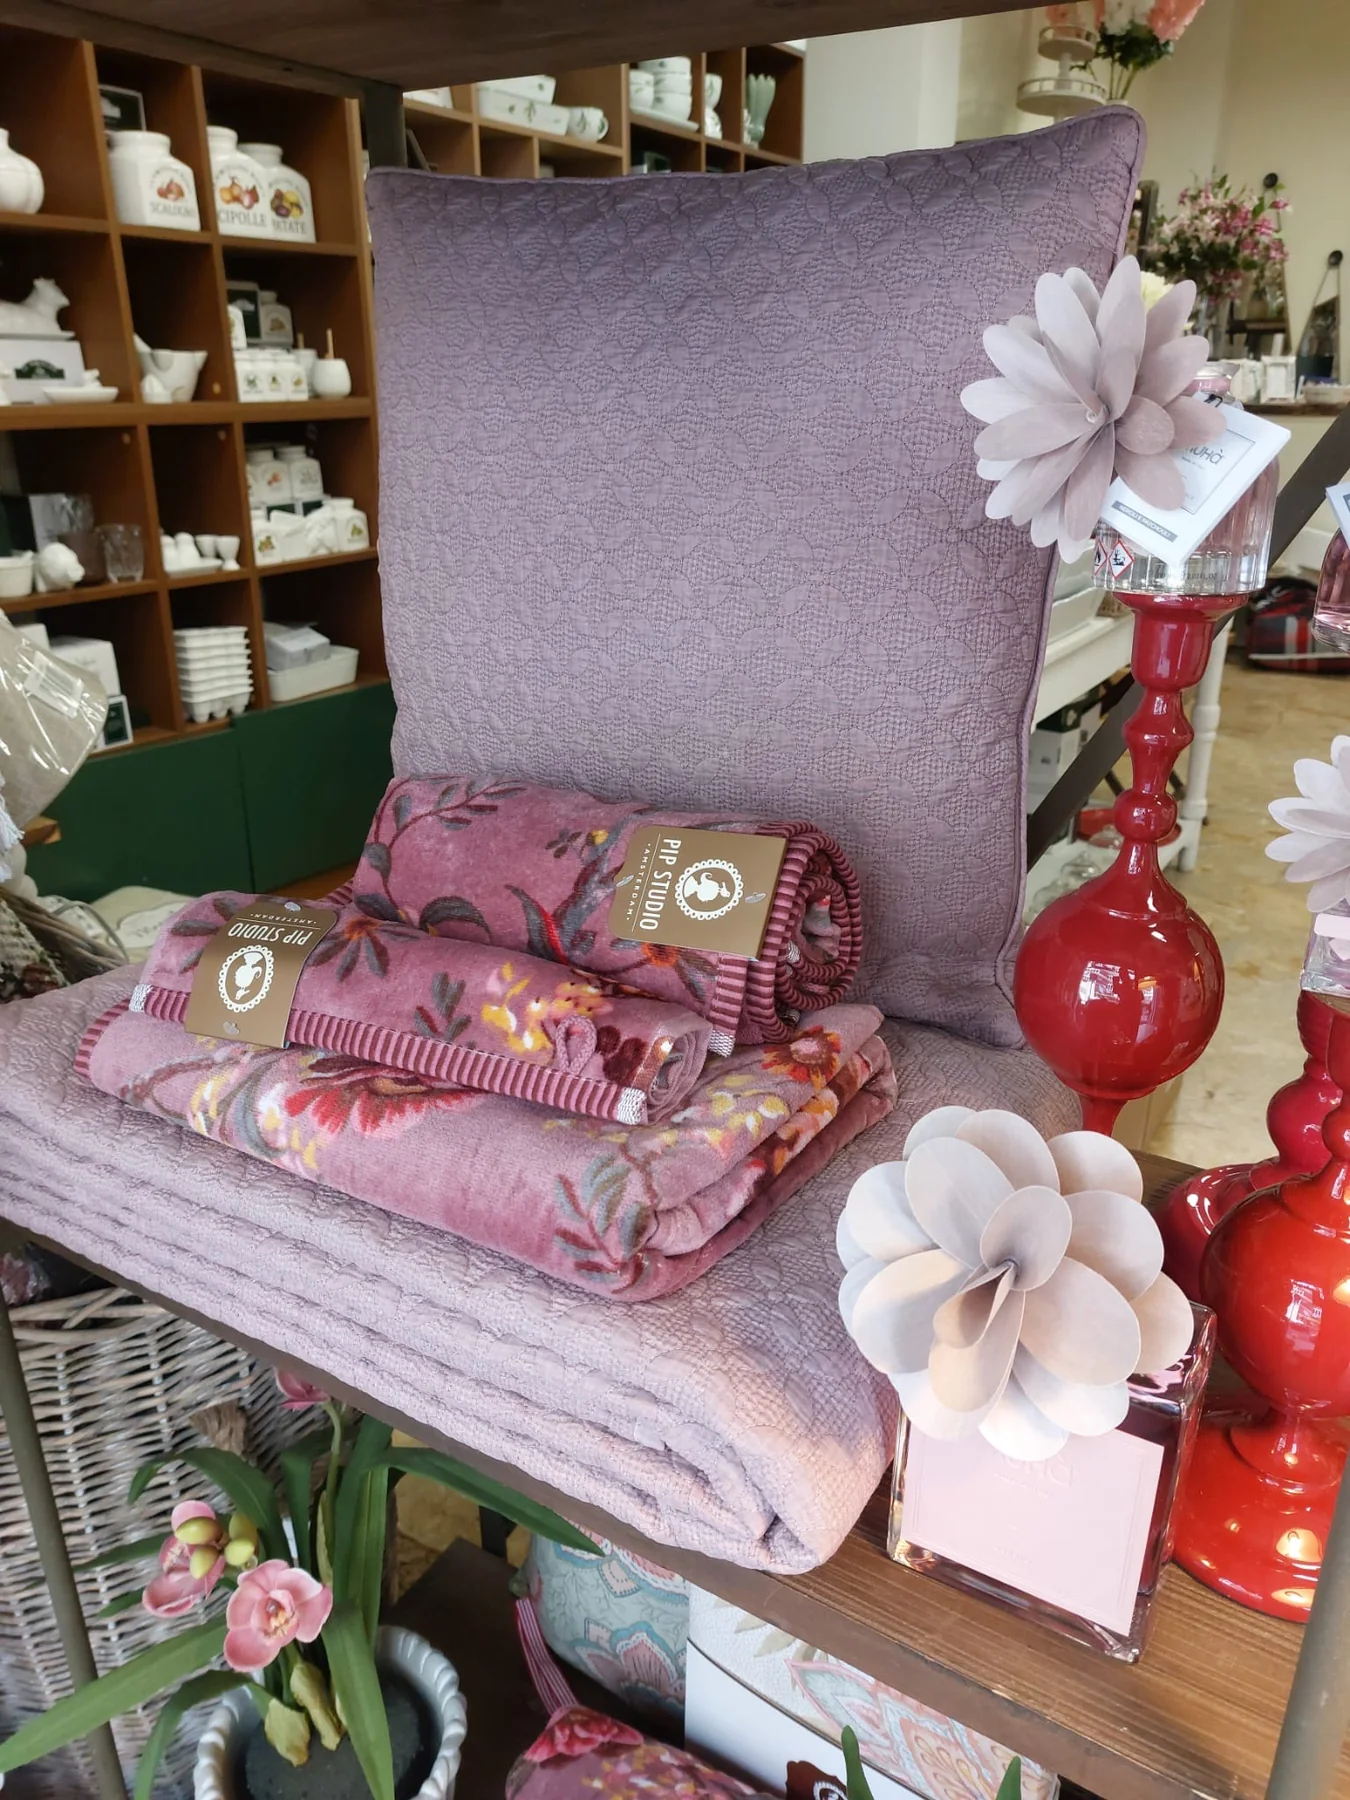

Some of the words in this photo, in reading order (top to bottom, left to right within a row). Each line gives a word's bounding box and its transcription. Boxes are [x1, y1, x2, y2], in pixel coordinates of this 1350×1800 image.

[218, 208, 267, 227] CIPOLLE
[658, 838, 681, 865] PIP
[639, 870, 672, 930] STUDIO
[228, 922, 285, 942] STUDIO
[282, 929, 313, 945] PIP
